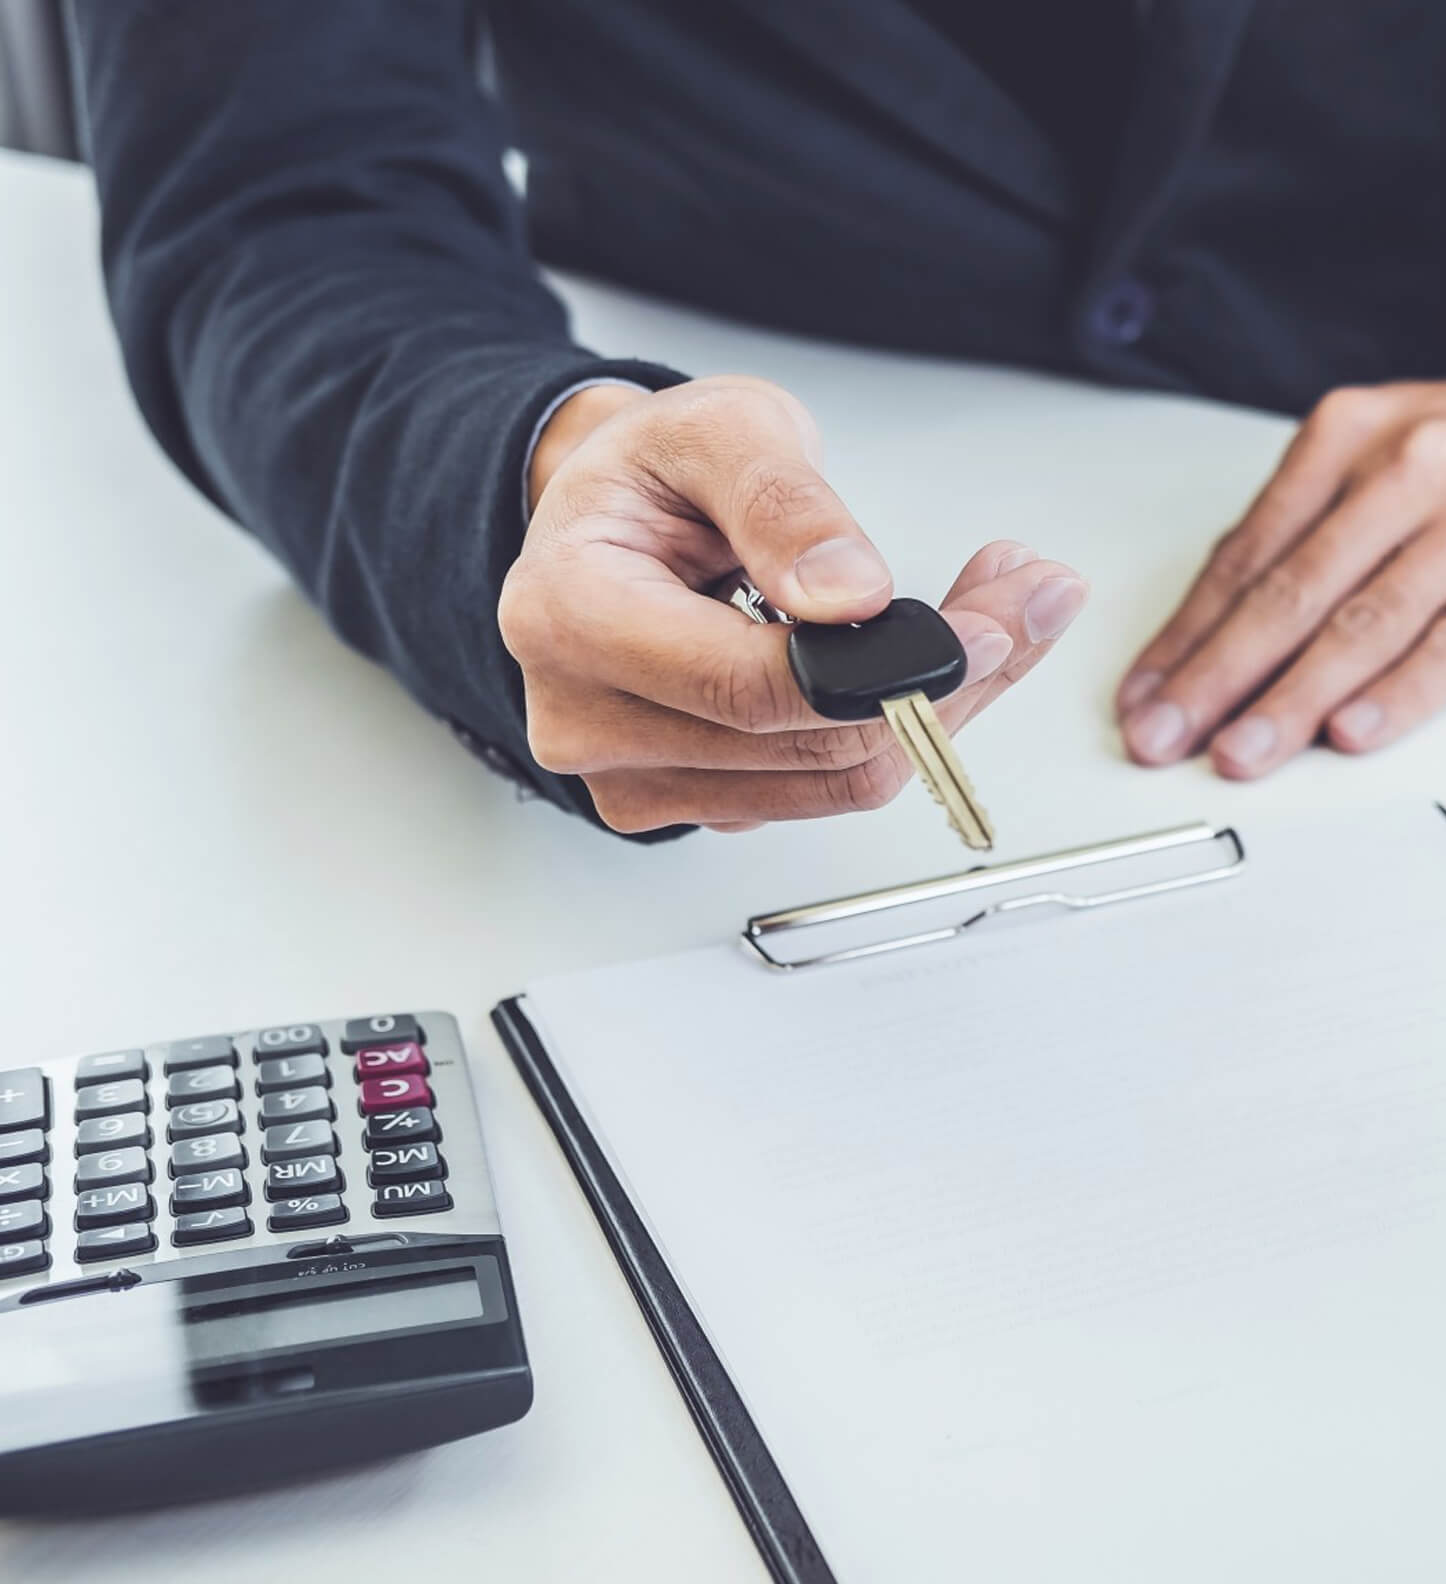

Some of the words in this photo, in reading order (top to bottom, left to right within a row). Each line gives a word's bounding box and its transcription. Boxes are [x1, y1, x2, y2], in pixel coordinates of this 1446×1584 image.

[370, 1016, 395, 1032] 0
[263, 1026, 312, 1045] 00
[366, 1047, 412, 1066] AC
[279, 1061, 296, 1077] 1
[189, 1071, 214, 1087] 2
[380, 1080, 410, 1097] C
[279, 1094, 306, 1109] 4
[100, 1118, 124, 1135] 6
[285, 1126, 311, 1144] 7
[191, 1140, 217, 1156] 8
[376, 1147, 428, 1165] MC
[99, 1153, 123, 1170] 9
[273, 1159, 326, 1179] MR
[83, 1188, 138, 1207] M+
[384, 1182, 431, 1199] MU
[288, 1197, 319, 1211] %
